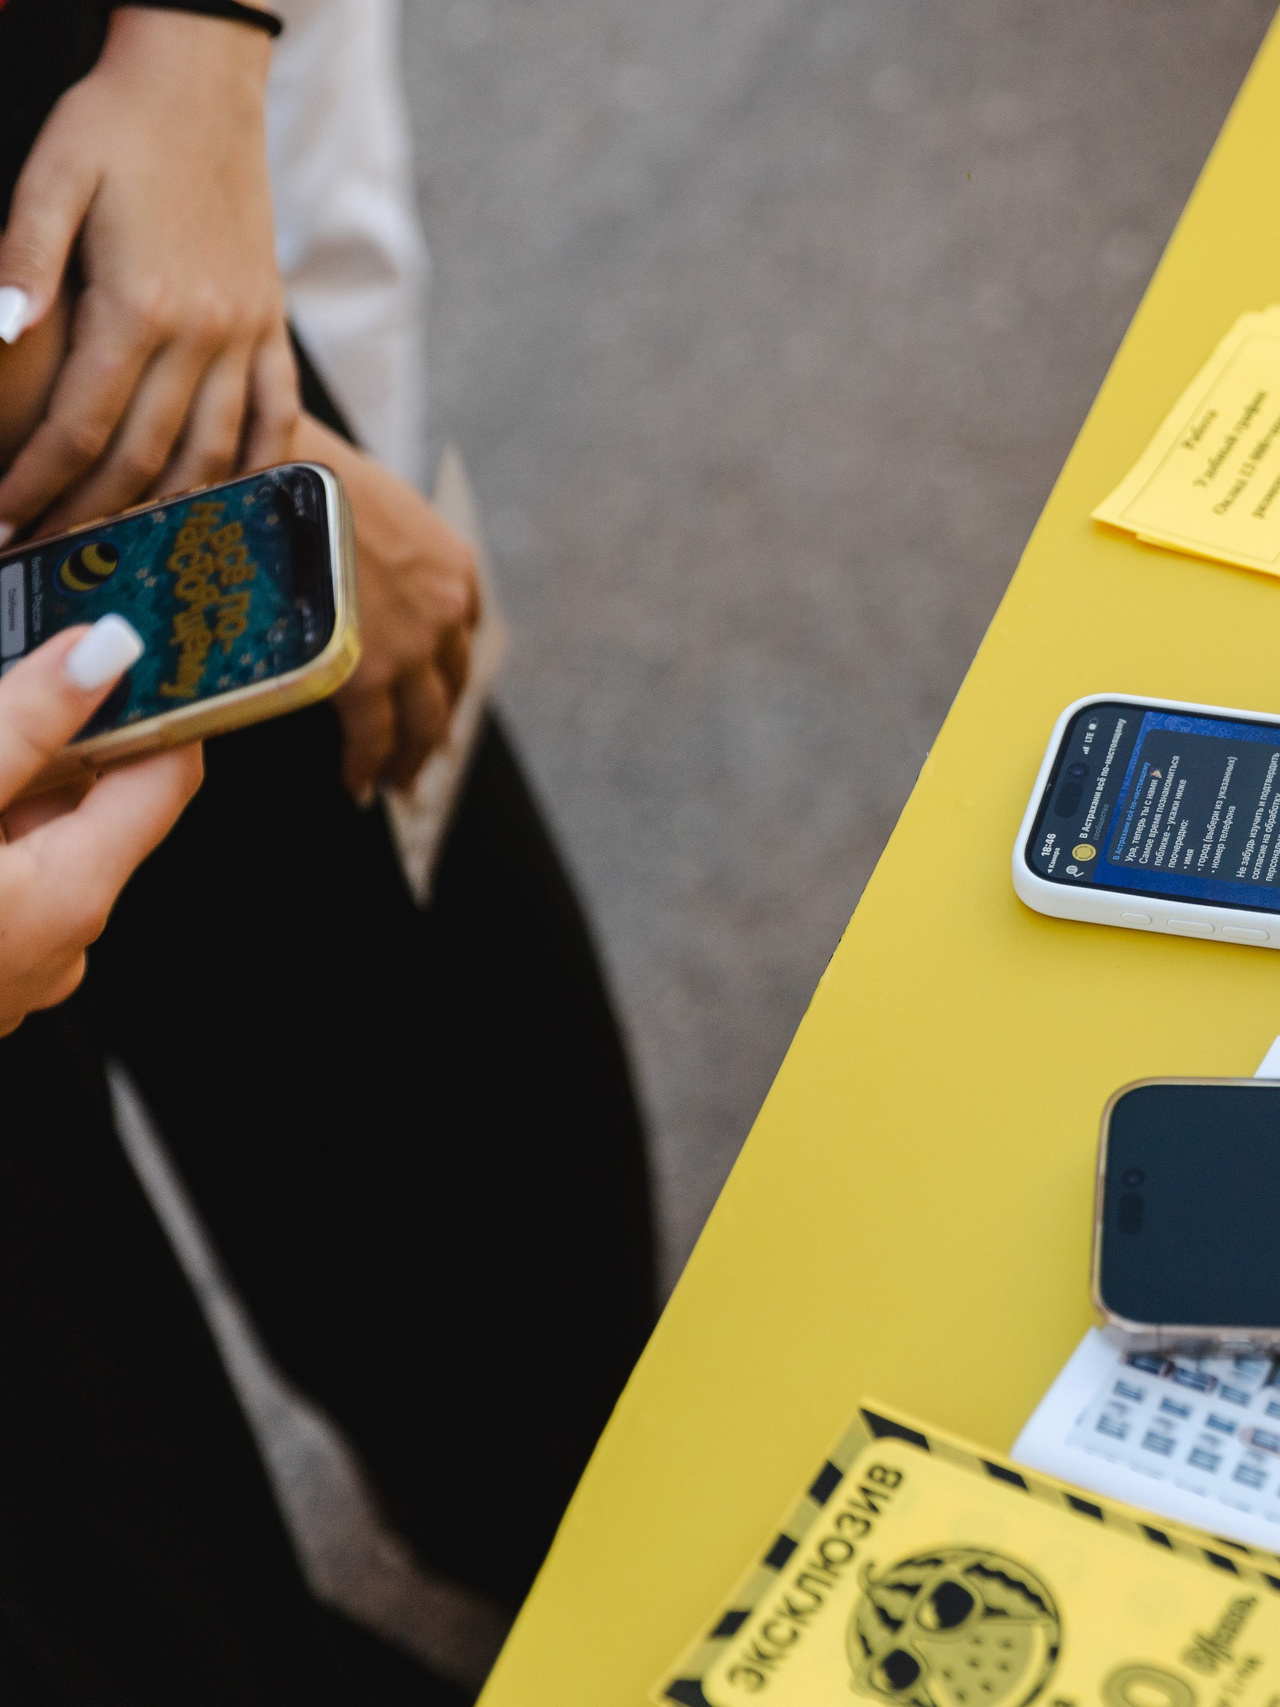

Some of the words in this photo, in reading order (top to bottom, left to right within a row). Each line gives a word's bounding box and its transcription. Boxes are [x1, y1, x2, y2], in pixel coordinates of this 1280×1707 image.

[1083, 732, 1094, 743] LTE
[1099, 718, 1127, 776] по-настоящему
[1094, 776, 1107, 790] всё
[1128, 761, 1151, 809] по-настоящему
[1145, 778, 1158, 799] нами
[1155, 755, 1180, 813] познакомиться
[1173, 778, 1187, 799] ниже
[1215, 755, 1238, 799] указанных)
[1081, 791, 1105, 832] Астрахани
[1124, 809, 1135, 821] всё
[1140, 805, 1150, 816] ты
[1165, 800, 1182, 825] укажи
[1213, 799, 1223, 809] из
[1091, 802, 1110, 840] сообщество
[1131, 817, 1148, 845] теперь
[1147, 813, 1164, 838] время
[1202, 809, 1222, 842] (выбери
[1216, 804, 1238, 842] телефона
[1248, 806, 1266, 838] изучить
[1040, 832, 1057, 857] 18:46
[1114, 820, 1133, 854] Астрахани
[1138, 837, 1154, 864] Самое
[1152, 830, 1171, 866] поближе
[1166, 819, 1190, 868] поочередно:
[1047, 846, 1061, 868] Камера
[1124, 844, 1140, 862] Ура,
[1183, 848, 1194, 864] имя
[1196, 842, 1212, 866] город
[1210, 842, 1226, 869] номер
[1239, 838, 1257, 866] забудь
[1249, 843, 1269, 880] согласие
[1260, 833, 1271, 843] на
[1235, 865, 1247, 877] Не
[726, 1463, 904, 1694] ЭКСКЛЮЗИВ
